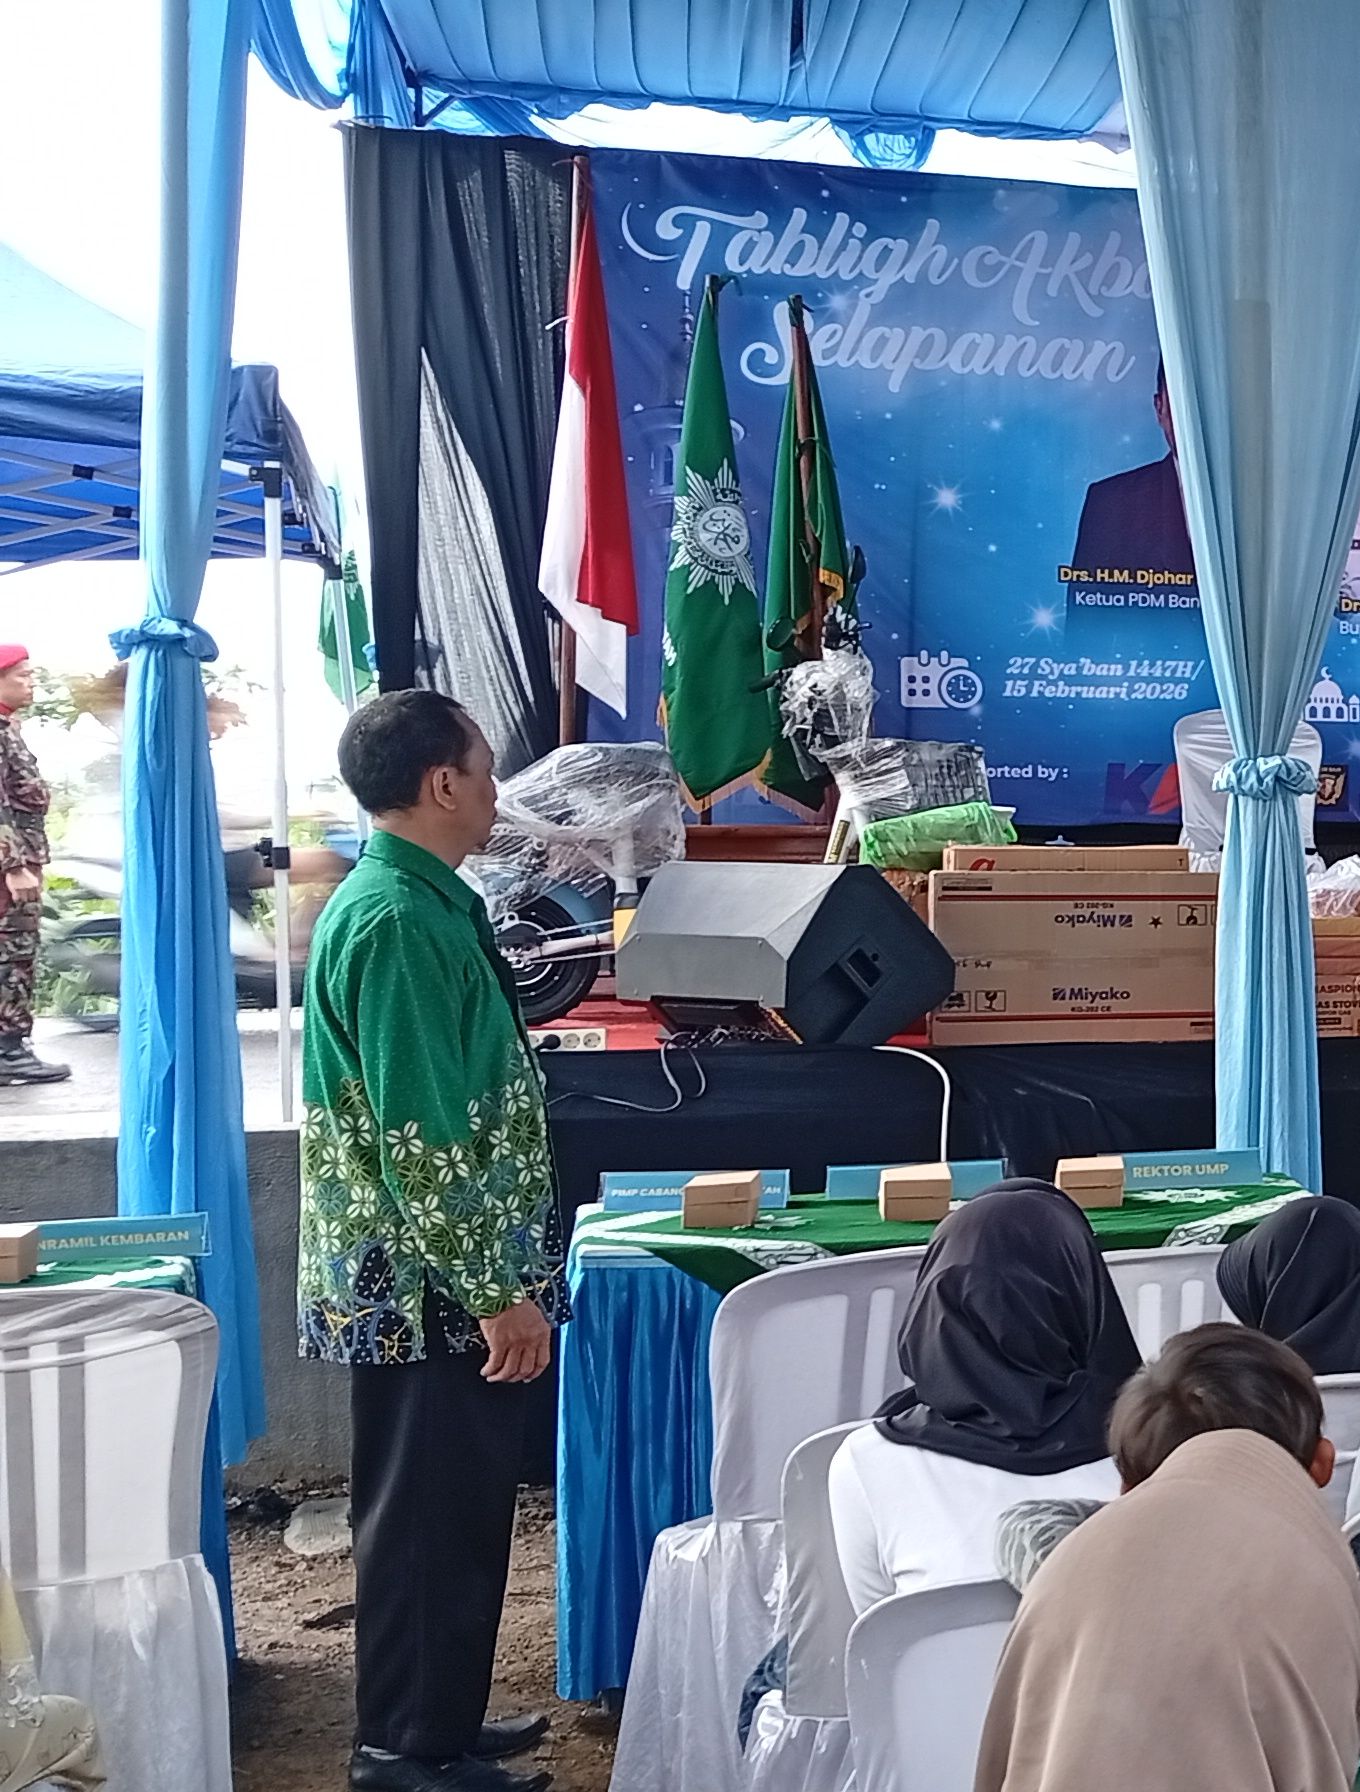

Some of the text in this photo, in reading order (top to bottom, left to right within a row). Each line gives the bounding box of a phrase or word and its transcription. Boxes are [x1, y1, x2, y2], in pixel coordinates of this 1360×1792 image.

[655, 204, 959, 305] Tabligh
[740, 299, 1136, 393] Selapanan
[1059, 567, 1194, 588] Drs. H.M. Djohar
[1075, 591, 1201, 609] Ketua PDM Ban
[1005, 656, 1035, 674] 27
[1002, 680, 1189, 700] 15 Februari 2026
[986, 764, 1033, 778] orted
[1054, 911, 1117, 928] Miyako
[1068, 987, 1131, 1004] Miyako
[1132, 1163, 1230, 1178] REKTOR UMP
[37, 1230, 190, 1251] NRAMIL KEMBARAN
